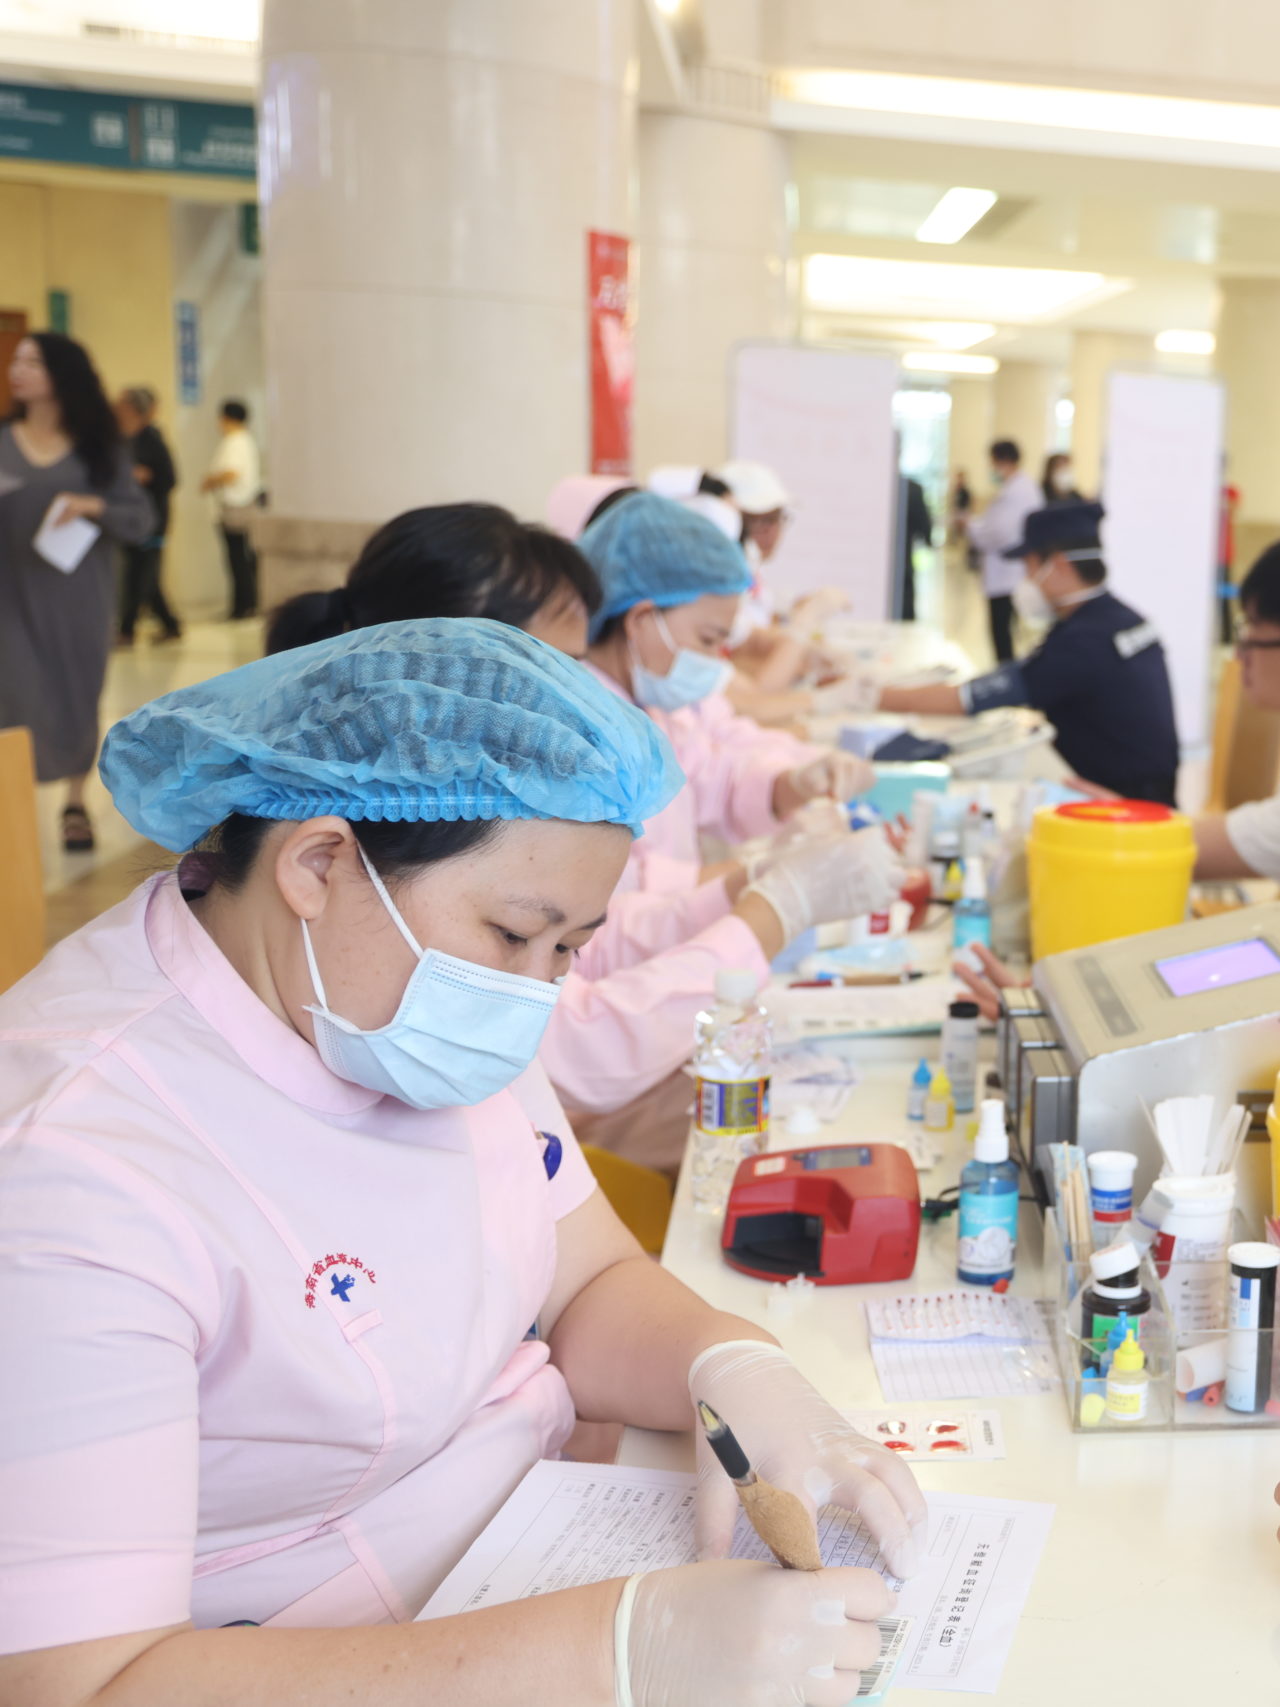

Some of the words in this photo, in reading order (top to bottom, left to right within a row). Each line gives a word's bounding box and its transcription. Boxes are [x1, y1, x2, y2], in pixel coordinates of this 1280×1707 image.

[305, 1252, 377, 1309] 海南省血液中心
